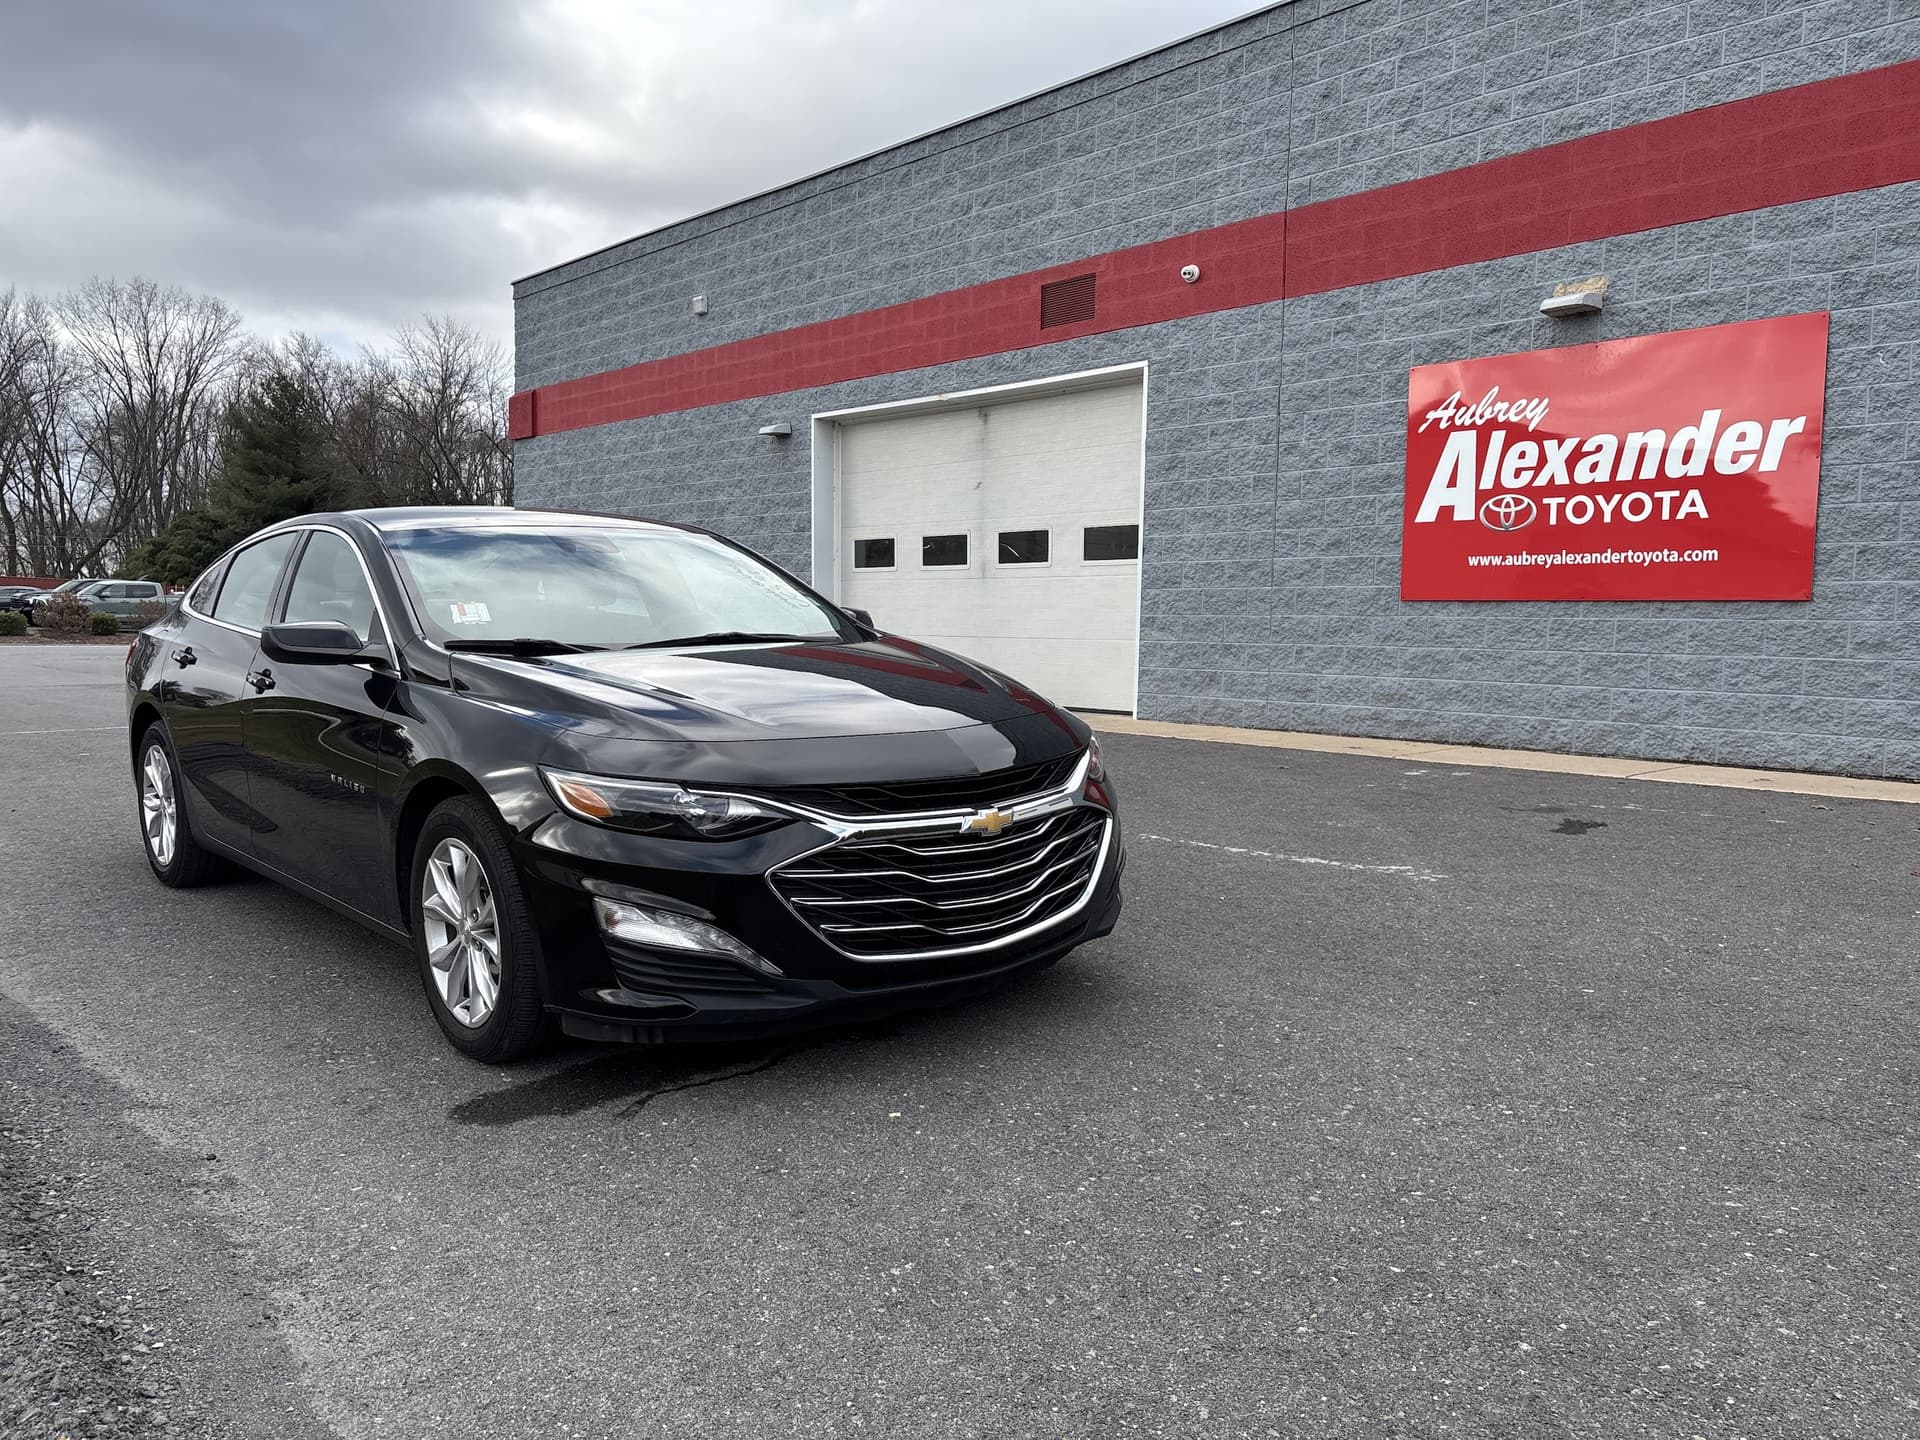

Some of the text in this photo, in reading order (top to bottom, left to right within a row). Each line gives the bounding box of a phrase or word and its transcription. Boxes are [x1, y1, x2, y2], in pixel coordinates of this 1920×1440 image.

[1417, 385, 1550, 434] Aubrey
[1414, 408, 1807, 523] Alexander
[1542, 488, 1709, 526] TOYOTA
[1468, 548, 1719, 568] www.aubreyalexandertoyota.com
